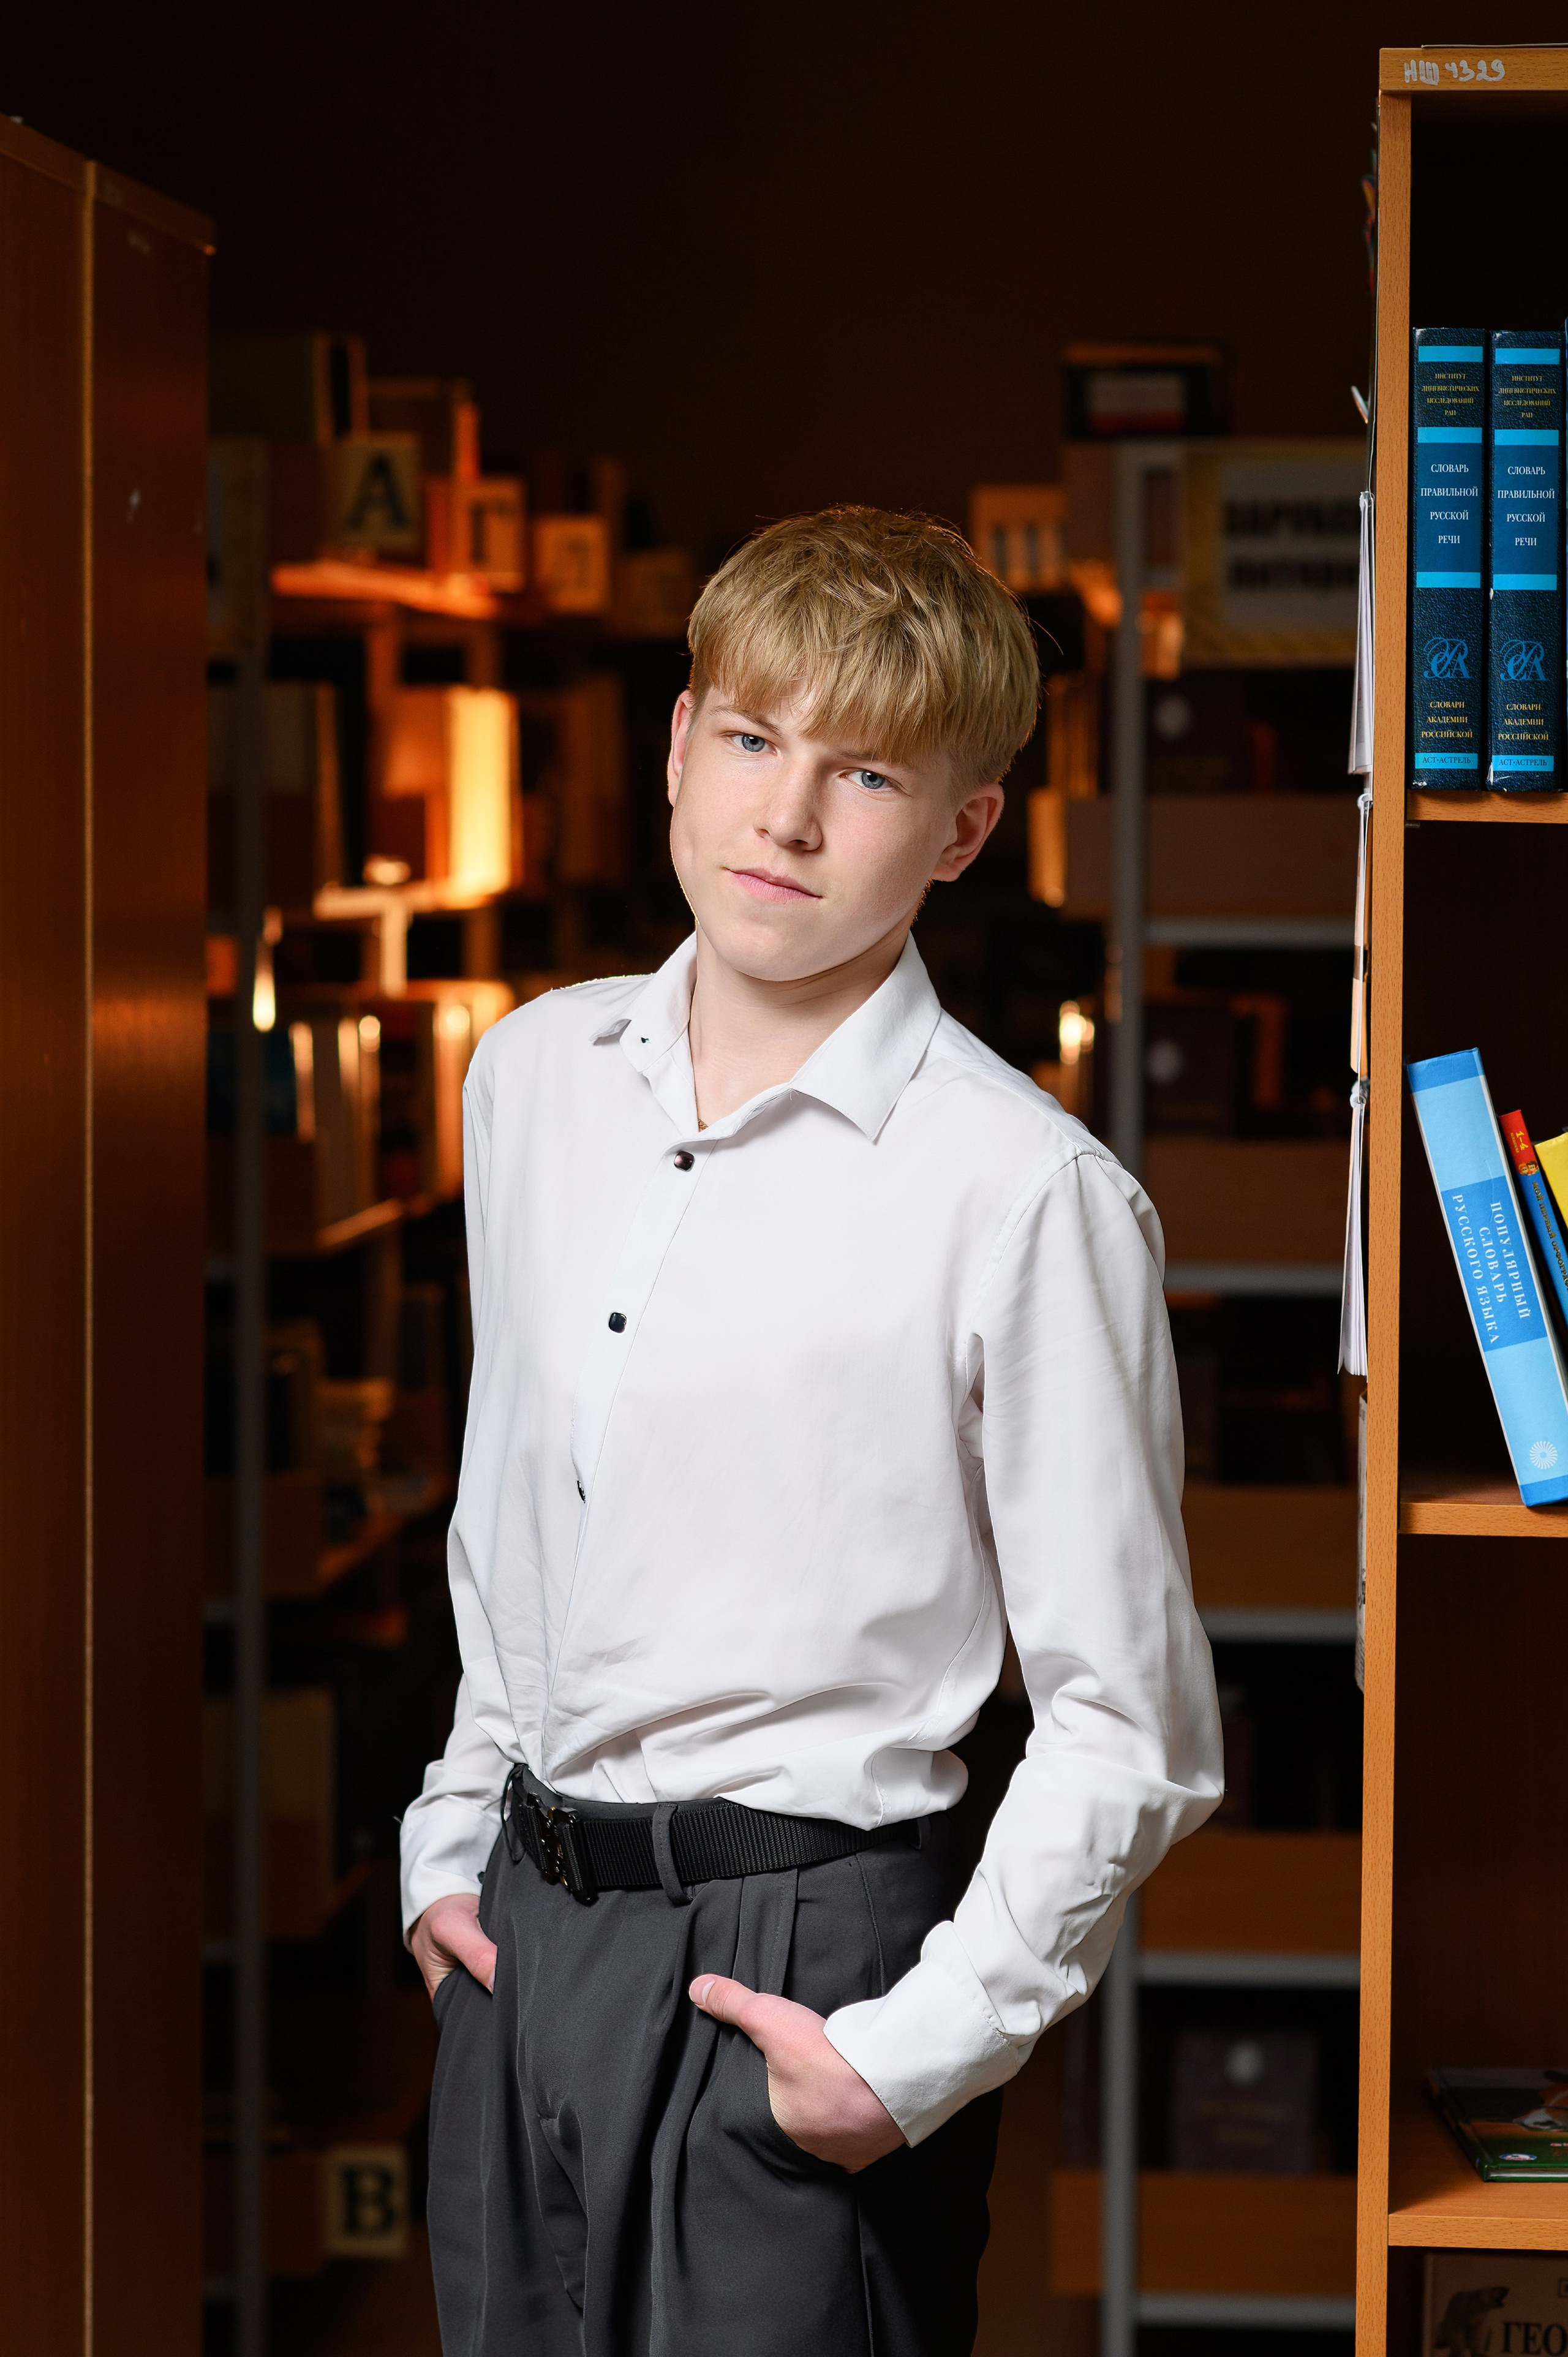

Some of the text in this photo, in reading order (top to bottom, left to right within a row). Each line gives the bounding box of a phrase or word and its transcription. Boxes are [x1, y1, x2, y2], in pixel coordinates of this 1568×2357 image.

[1445, 59, 1505, 81] 4329
[1431, 464, 1469, 473] СЛОВАРЬ
[1507, 466, 1546, 475] СЛОВАРЬ
[1420, 486, 1478, 497] ПРАВИЛЬНОЙ
[1498, 488, 1555, 499] ПРАВИЛЬНОЙ
[1430, 510, 1469, 520] РУССКОЙ
[1507, 512, 1545, 522] РУССКОЙ
[1438, 535, 1460, 544] РЕЧИ
[1515, 537, 1537, 546] РЕЧИ
[1421, 730, 1473, 738] РОССИЙСКОЙ
[1498, 732, 1549, 741] РОССИЙСКОЙ
[1532, 1182, 1544, 1202] МОЙ
[1539, 1203, 1556, 1239] ПЕРВЫЙ
[1479, 1227, 1507, 1303] СЛОВАРЬ
[1490, 1201, 1531, 1319] ПОПУЛЯРНЫЙ
[1452, 1193, 1500, 1343] РУССКОГО ЯЗЫКА
